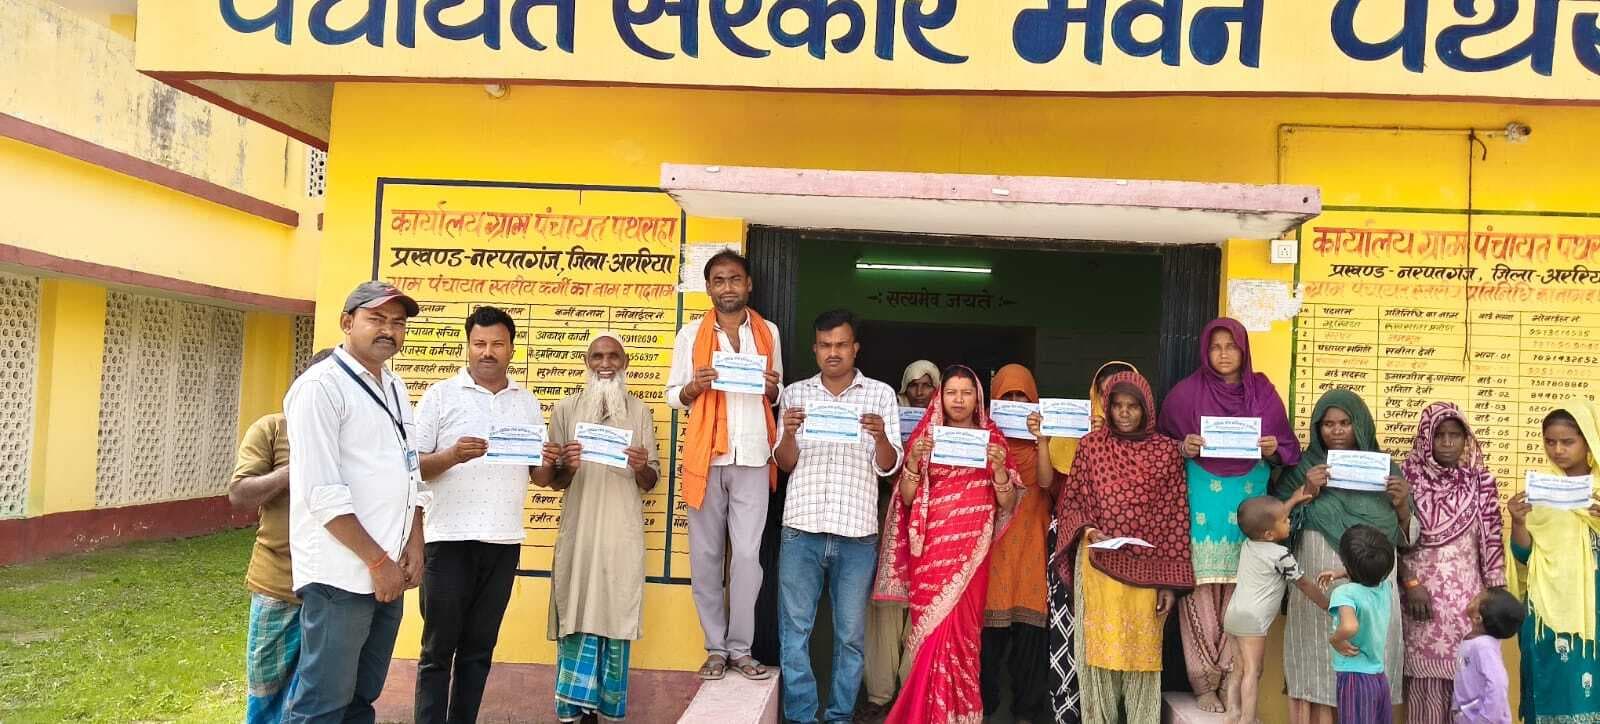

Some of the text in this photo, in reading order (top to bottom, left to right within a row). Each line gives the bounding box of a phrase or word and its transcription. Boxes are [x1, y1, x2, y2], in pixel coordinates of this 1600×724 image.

[391, 200, 481, 240] कार्यालय
[482, 211, 533, 242] ग्राम
[535, 206, 610, 242] पंचायत
[1312, 218, 1416, 257] कार्यालय
[1417, 228, 1468, 261] ग्राम
[1473, 225, 1553, 261] पंचायत
[427, 274, 488, 295] पंचायत
[887, 287, 995, 310] सत्यमेव जयते
[428, 343, 464, 358] कर्मचारी
